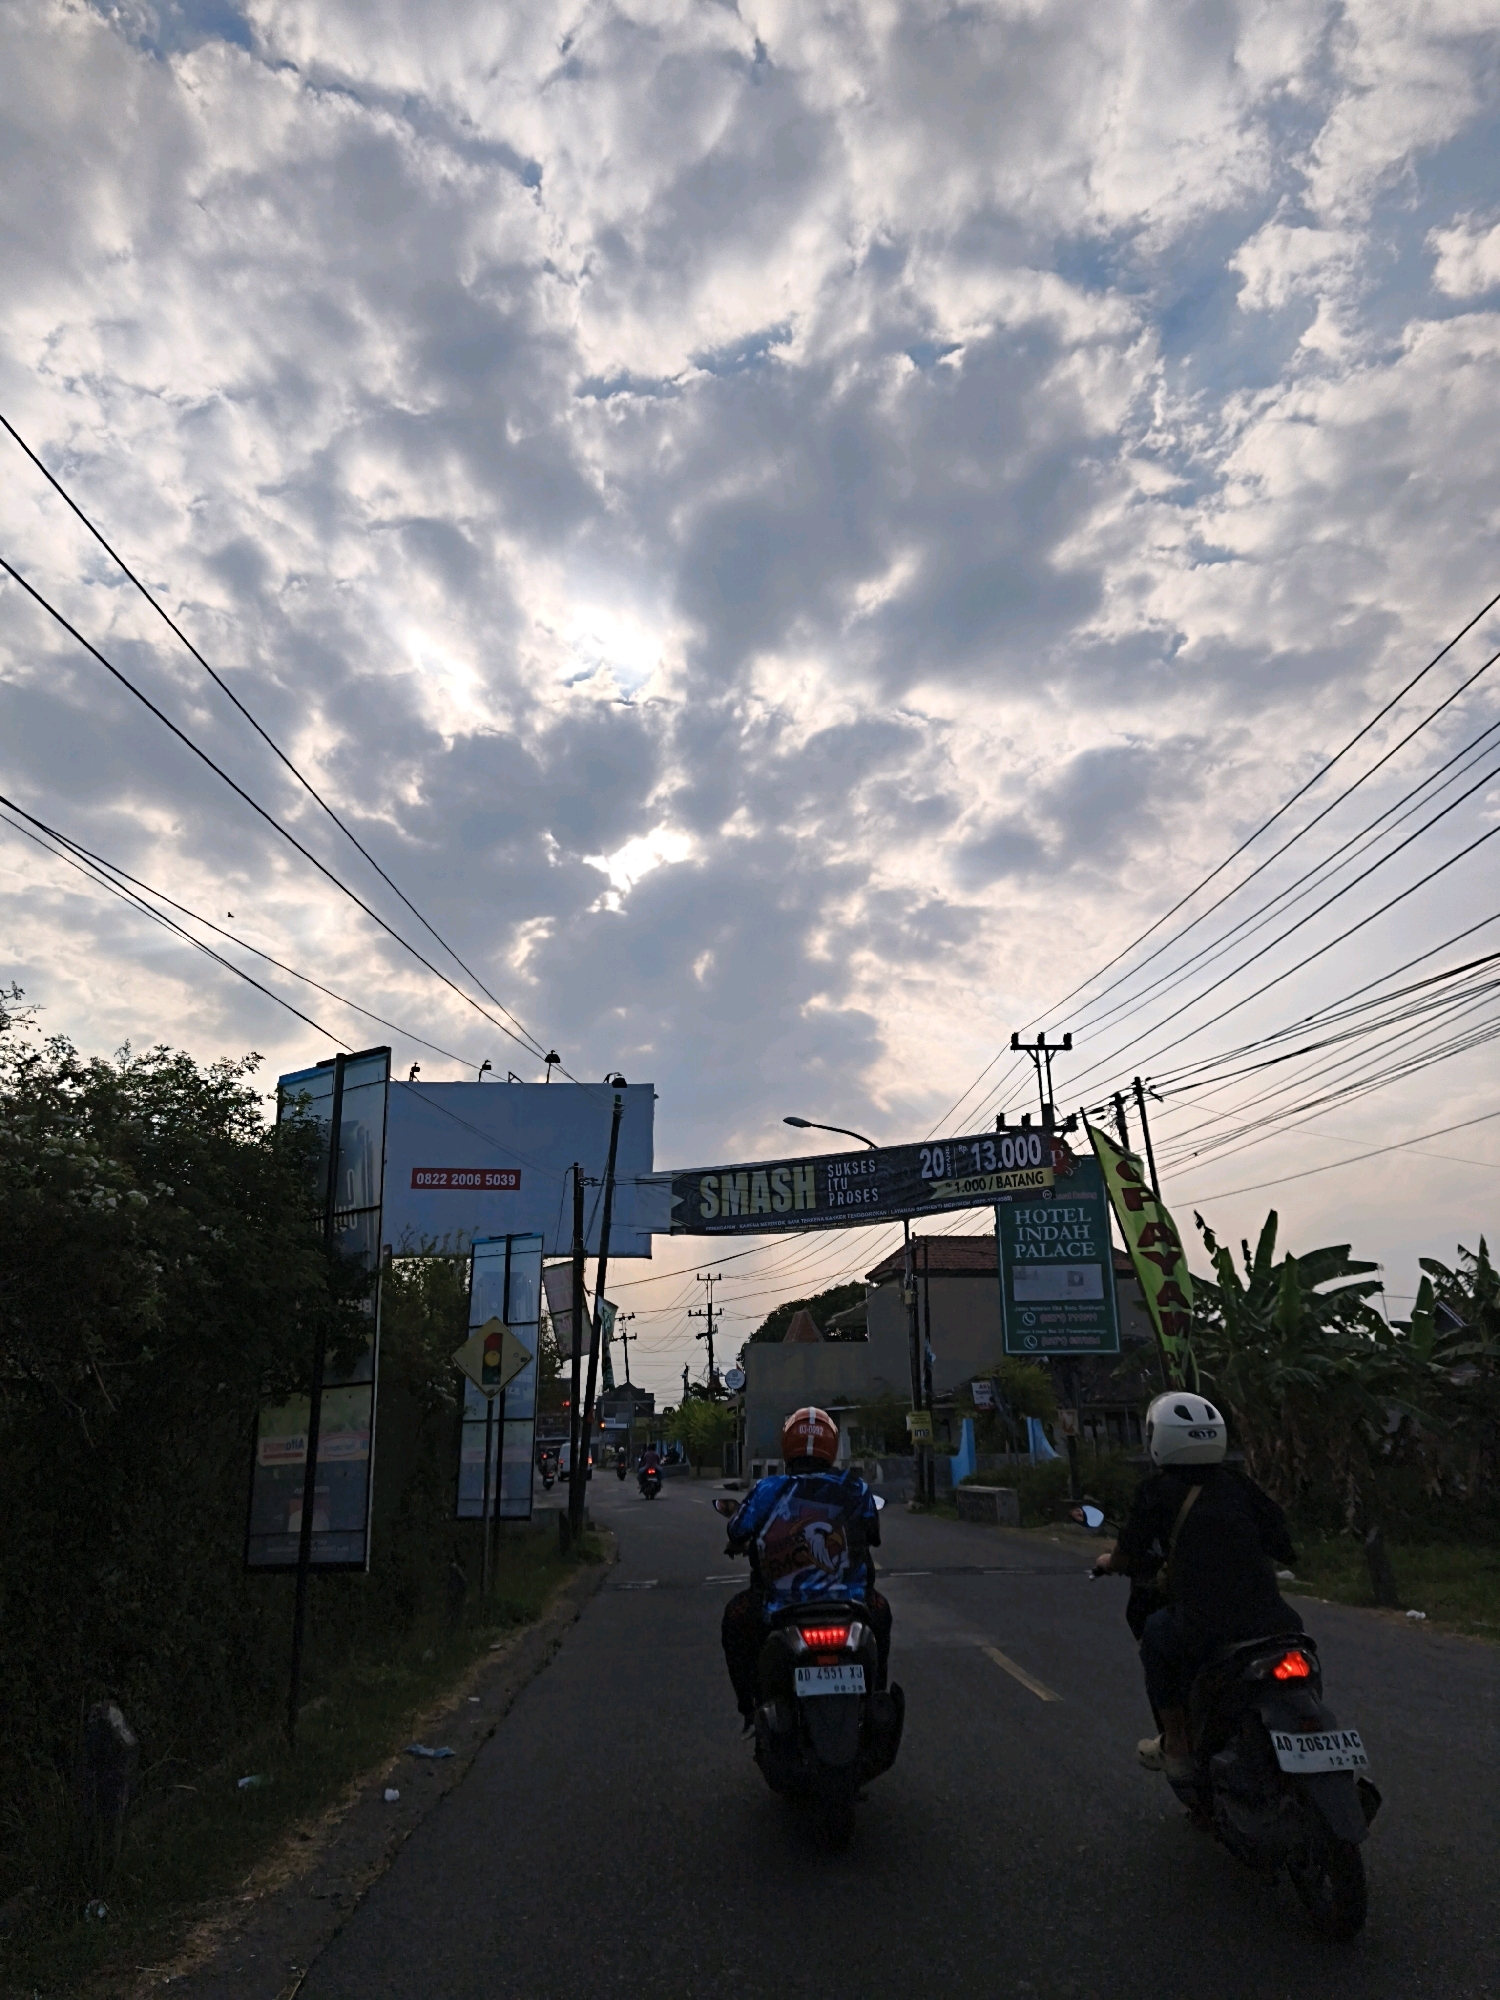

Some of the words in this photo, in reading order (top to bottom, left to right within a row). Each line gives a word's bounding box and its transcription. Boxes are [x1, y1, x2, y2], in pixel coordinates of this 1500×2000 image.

[970, 1133, 1042, 1172] 13.000
[827, 1159, 876, 1178] SUKSES
[919, 1147, 945, 1179] 20
[416, 1172, 448, 1185] 0822
[450, 1173, 482, 1186] 2006
[485, 1174, 516, 1186] 5039
[827, 1177, 848, 1192] ITU
[954, 1178, 987, 1194] 1.000
[996, 1170, 1045, 1189] BATANG
[700, 1165, 817, 1219] SMASH
[829, 1187, 878, 1207] PROSES
[1014, 1207, 1092, 1225] HOTEL
[1017, 1224, 1091, 1241] INDAH
[1013, 1241, 1097, 1259] PALACE
[798, 1668, 811, 1682] AD
[816, 1667, 843, 1680] 4551
[1275, 1735, 1293, 1752] AD
